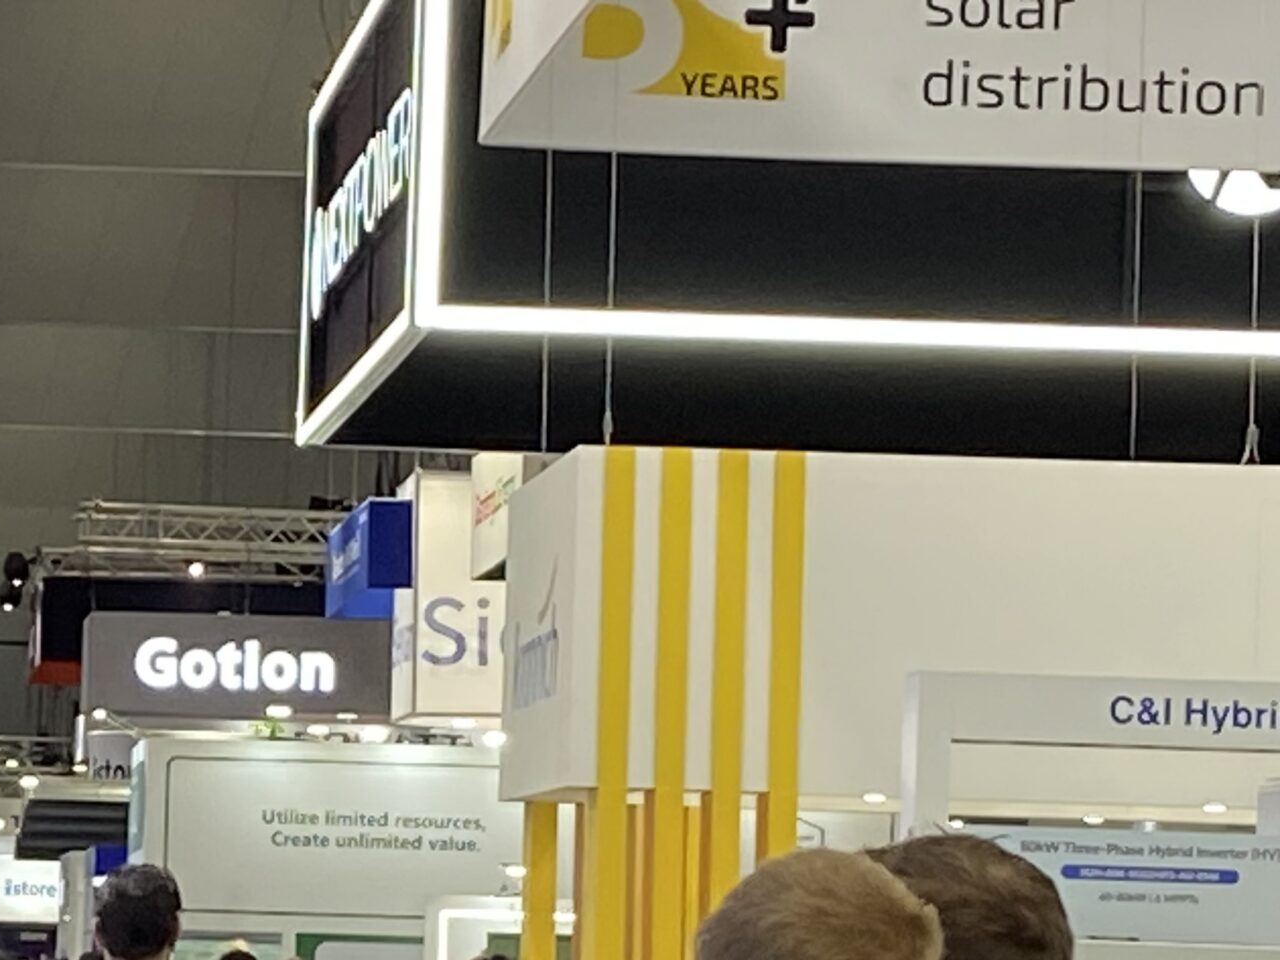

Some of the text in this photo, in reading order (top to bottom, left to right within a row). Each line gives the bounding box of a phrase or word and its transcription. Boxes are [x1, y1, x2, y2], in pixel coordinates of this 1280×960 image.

[925, 0, 1070, 30] solar
[680, 72, 780, 101] YEARS
[922, 59, 1266, 117] distribution
[421, 596, 506, 667] Si
[1110, 695, 1172, 726] C&I
[261, 808, 487, 833] Utilize limited resources,
[270, 830, 482, 852] Create unlimited value.
